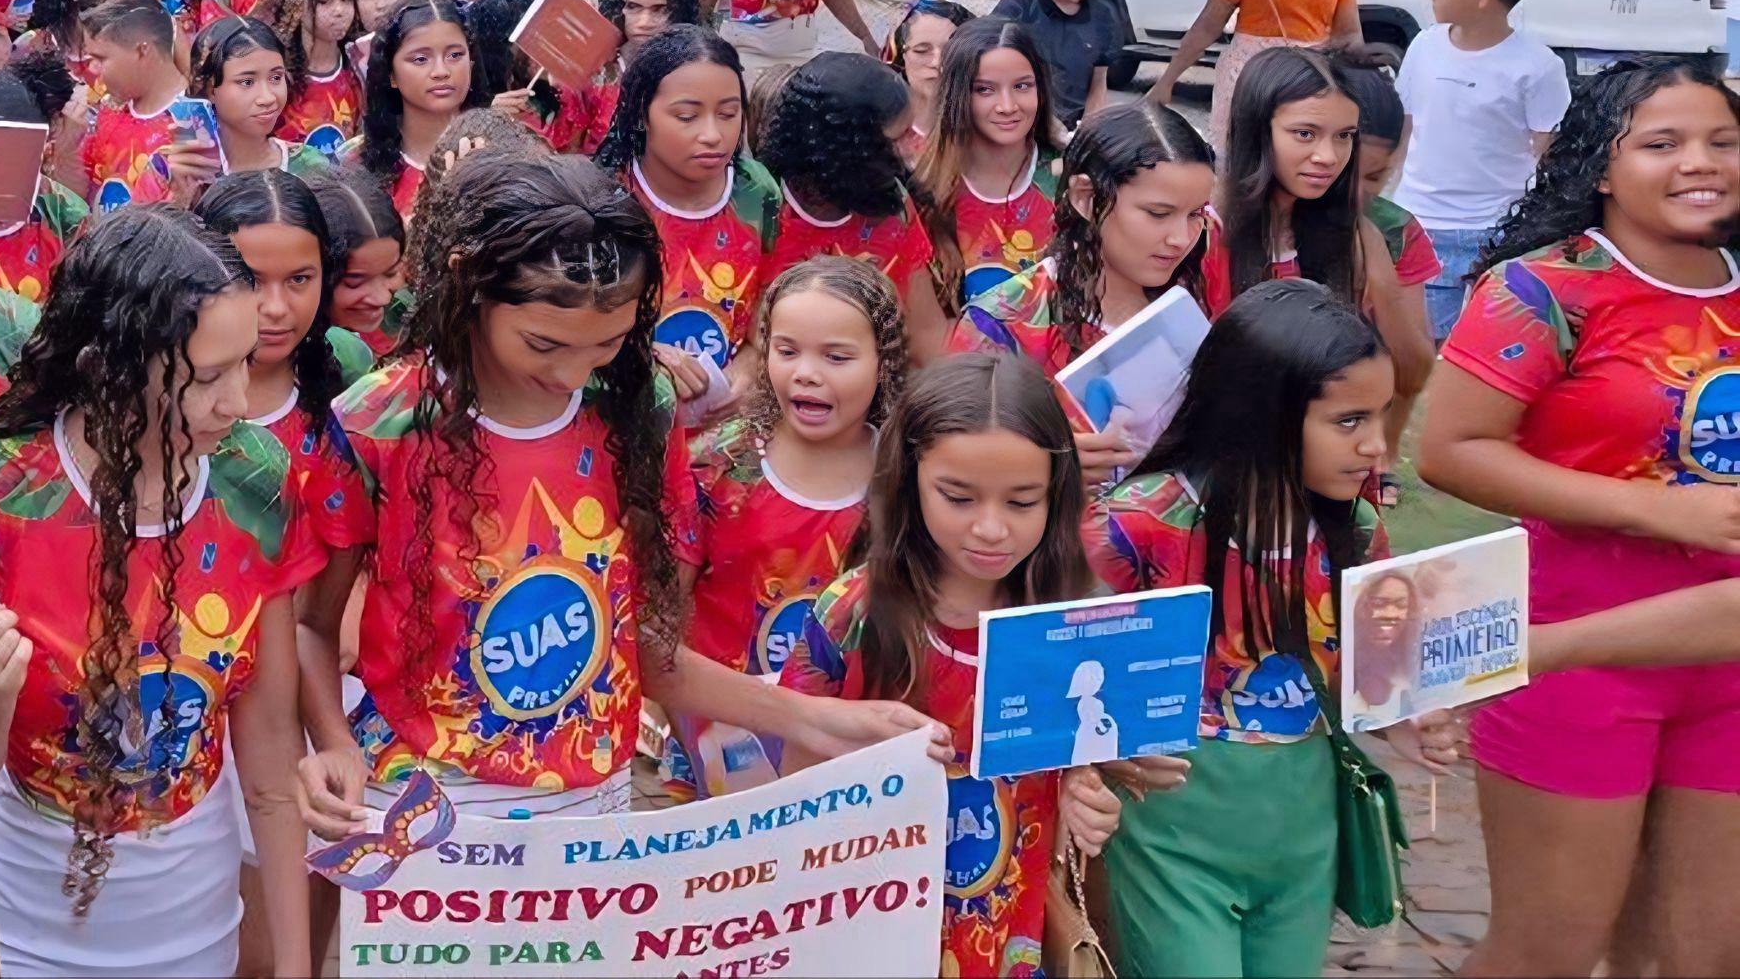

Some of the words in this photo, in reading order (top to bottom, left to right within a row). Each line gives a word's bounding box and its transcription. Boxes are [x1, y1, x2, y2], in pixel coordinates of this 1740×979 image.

[483, 602, 588, 673] SUAS
[437, 841, 526, 866] SEM
[881, 774, 905, 797] O
[362, 882, 659, 924] POSITIVO
[684, 859, 778, 899] PODE
[801, 824, 928, 871] MUDAR
[350, 943, 472, 967] TUDO
[489, 940, 605, 966] PARA
[631, 876, 931, 962] NEGATIVO!
